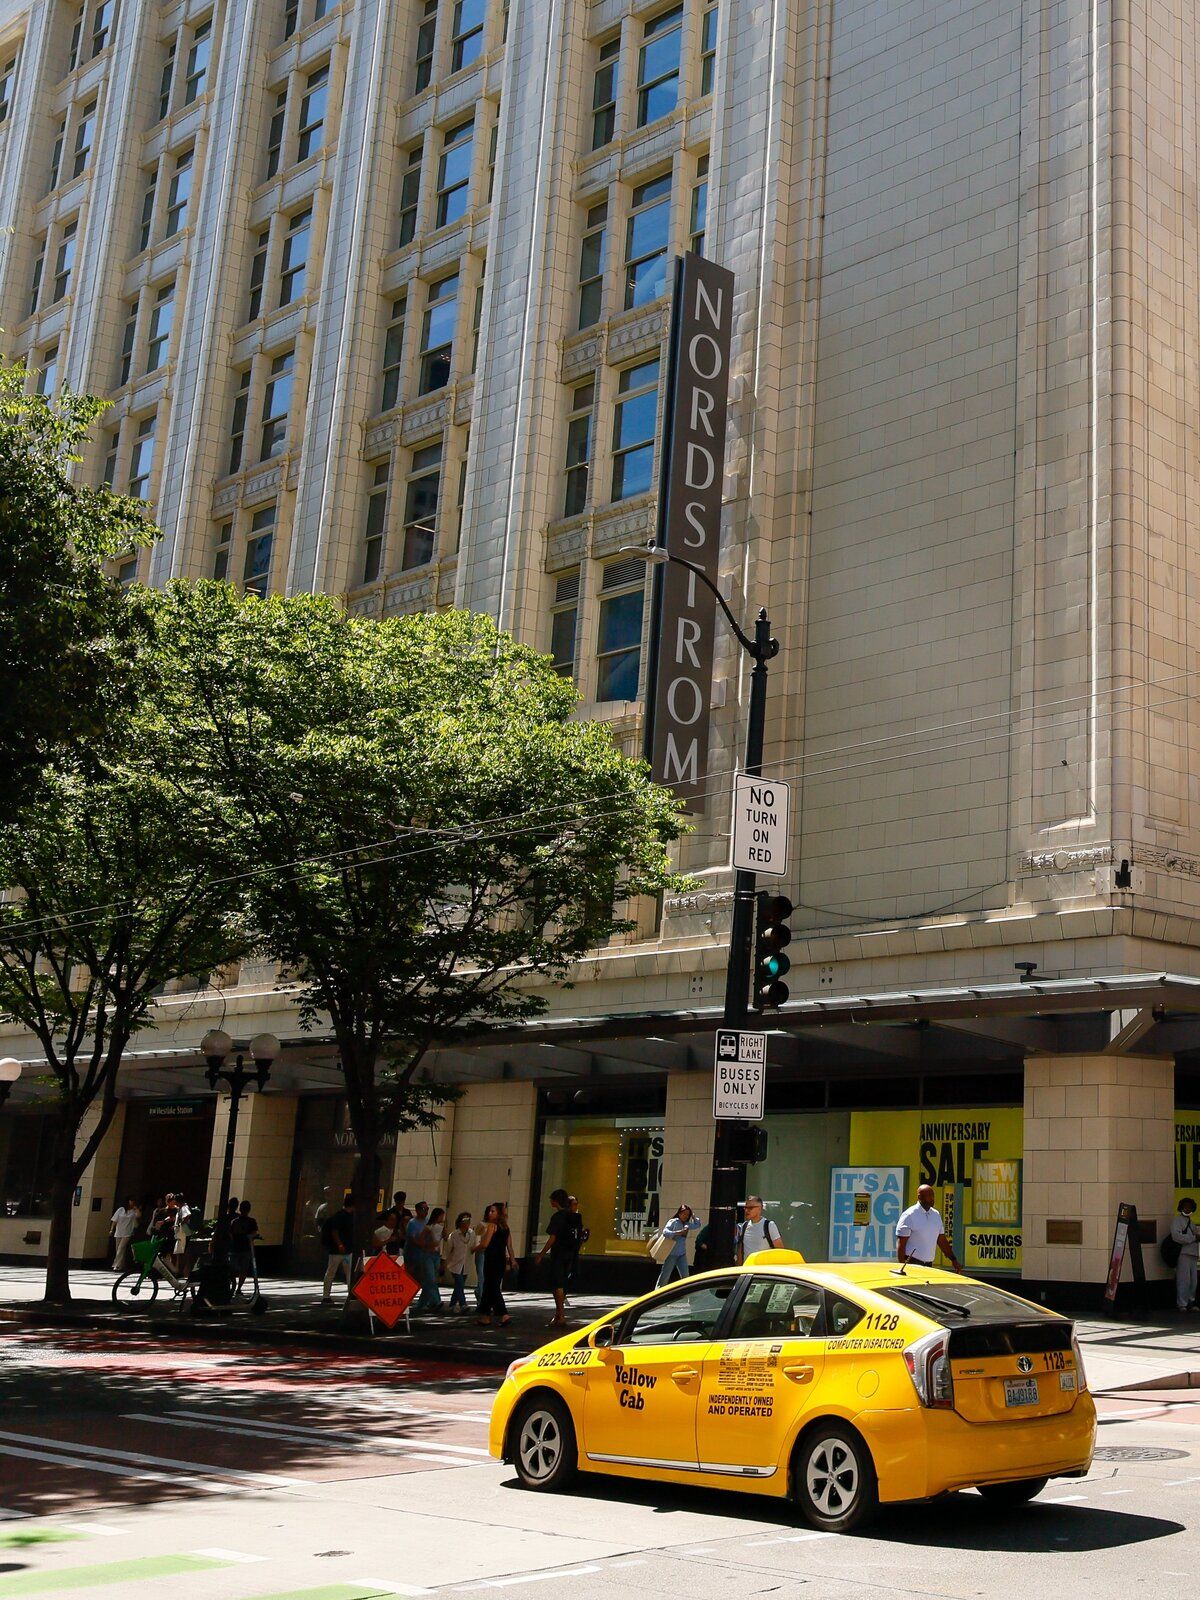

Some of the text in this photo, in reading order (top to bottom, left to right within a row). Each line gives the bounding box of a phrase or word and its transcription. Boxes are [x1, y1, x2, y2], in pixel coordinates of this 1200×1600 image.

[663, 278, 722, 785] NORDSTROM
[750, 786, 775, 807] NO
[746, 808, 777, 827] TURN
[752, 828, 769, 844] ON
[748, 846, 772, 863] RED
[740, 1036, 764, 1047] RIGHT
[741, 1049, 762, 1060] LANE
[720, 1067, 760, 1081] BUSES
[723, 1082, 756, 1095] ONLY
[718, 1101, 749, 1110] BICYCLES
[919, 1121, 991, 1142] ANNIVERSARY
[974, 1162, 1018, 1182] NEW
[834, 1173, 899, 1192] IT'S A
[975, 1183, 1017, 1201] ARRIVALS
[834, 1193, 900, 1225] BG
[975, 1201, 1017, 1221] ON SALE
[620, 1220, 648, 1240] SALE
[969, 1233, 1023, 1247] SAVINGS
[977, 1246, 1017, 1260] (APPLAUSE)
[369, 1271, 403, 1281] STREET
[369, 1284, 405, 1295] CLOSED
[373, 1297, 403, 1308] AHEAD
[866, 1312, 900, 1331] 1128
[827, 1338, 905, 1350] COMPUTER DISPATCHED
[537, 1351, 592, 1367] 622-6500
[1043, 1352, 1065, 1370] 1128
[615, 1364, 658, 1389] Yellow
[619, 1388, 645, 1411] Cab
[708, 1394, 774, 1406] INDEPENDENTLY OWNED
[708, 1405, 773, 1417] AND OPERATED
